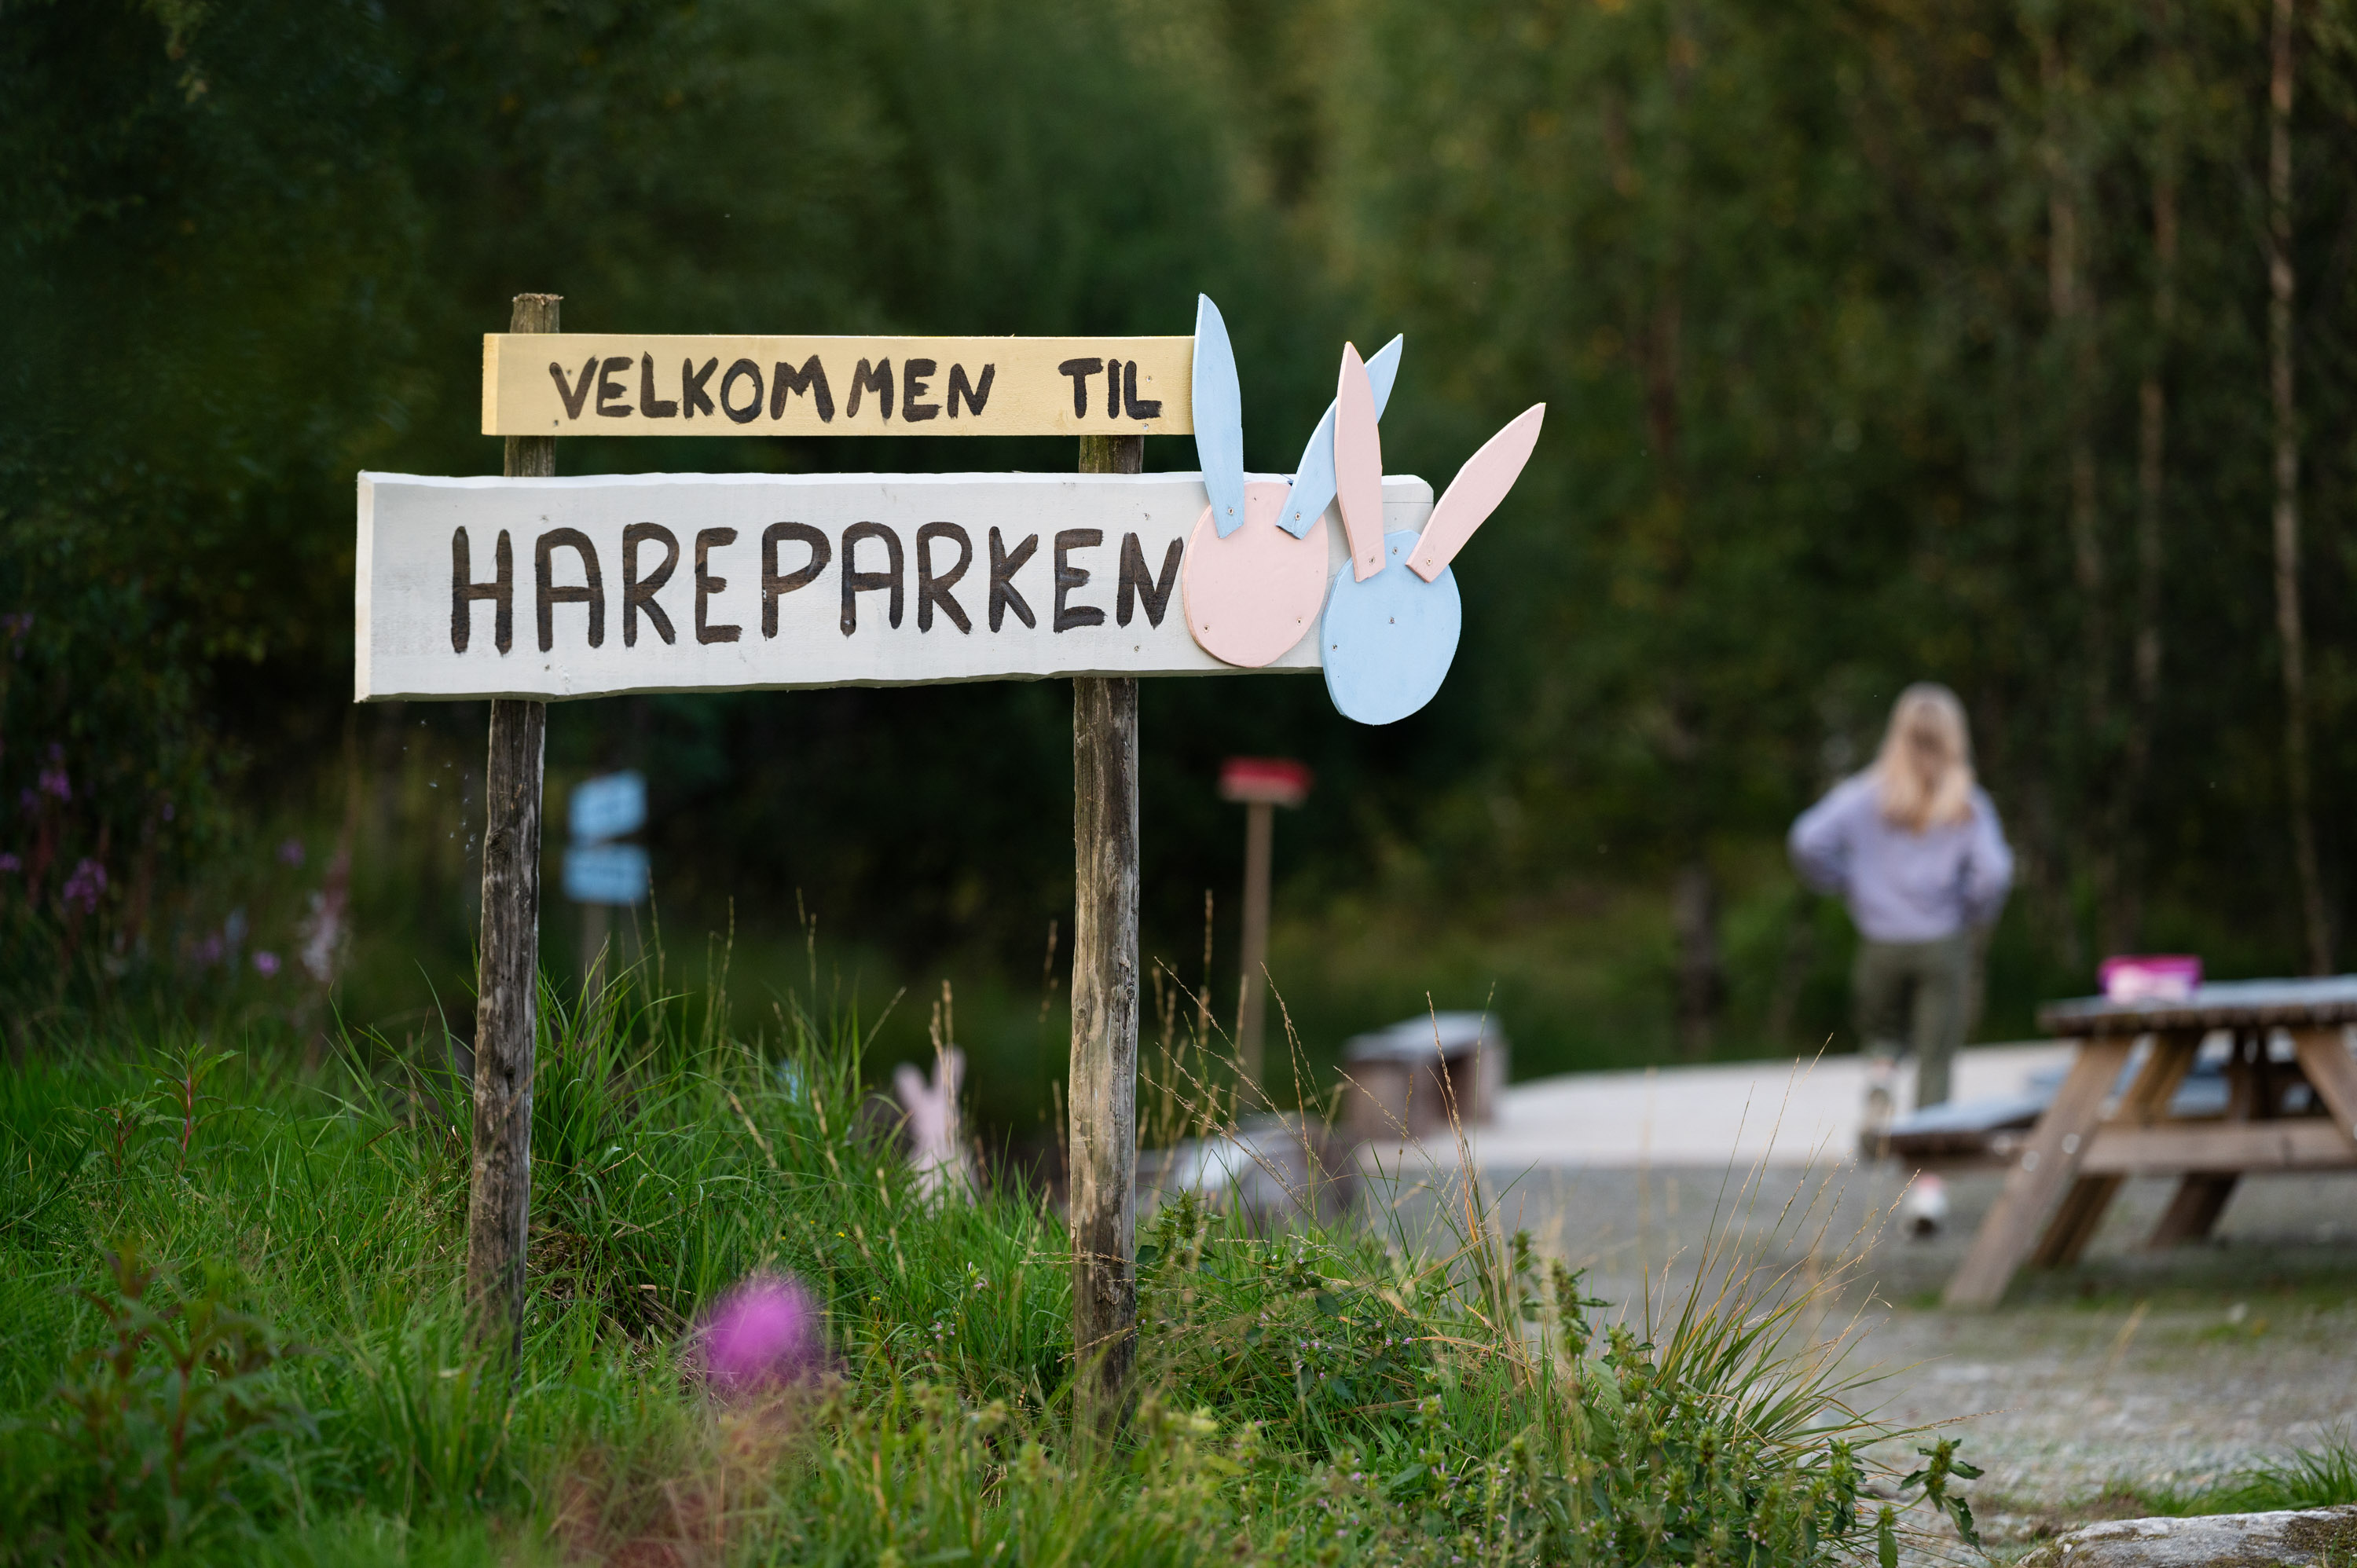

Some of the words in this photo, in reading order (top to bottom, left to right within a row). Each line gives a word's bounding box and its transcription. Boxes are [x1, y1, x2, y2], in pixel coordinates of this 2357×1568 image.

[548, 351, 996, 424] VELKOMMEN
[1058, 357, 1163, 421] TIL
[450, 521, 1185, 657] HAREPARKEN
